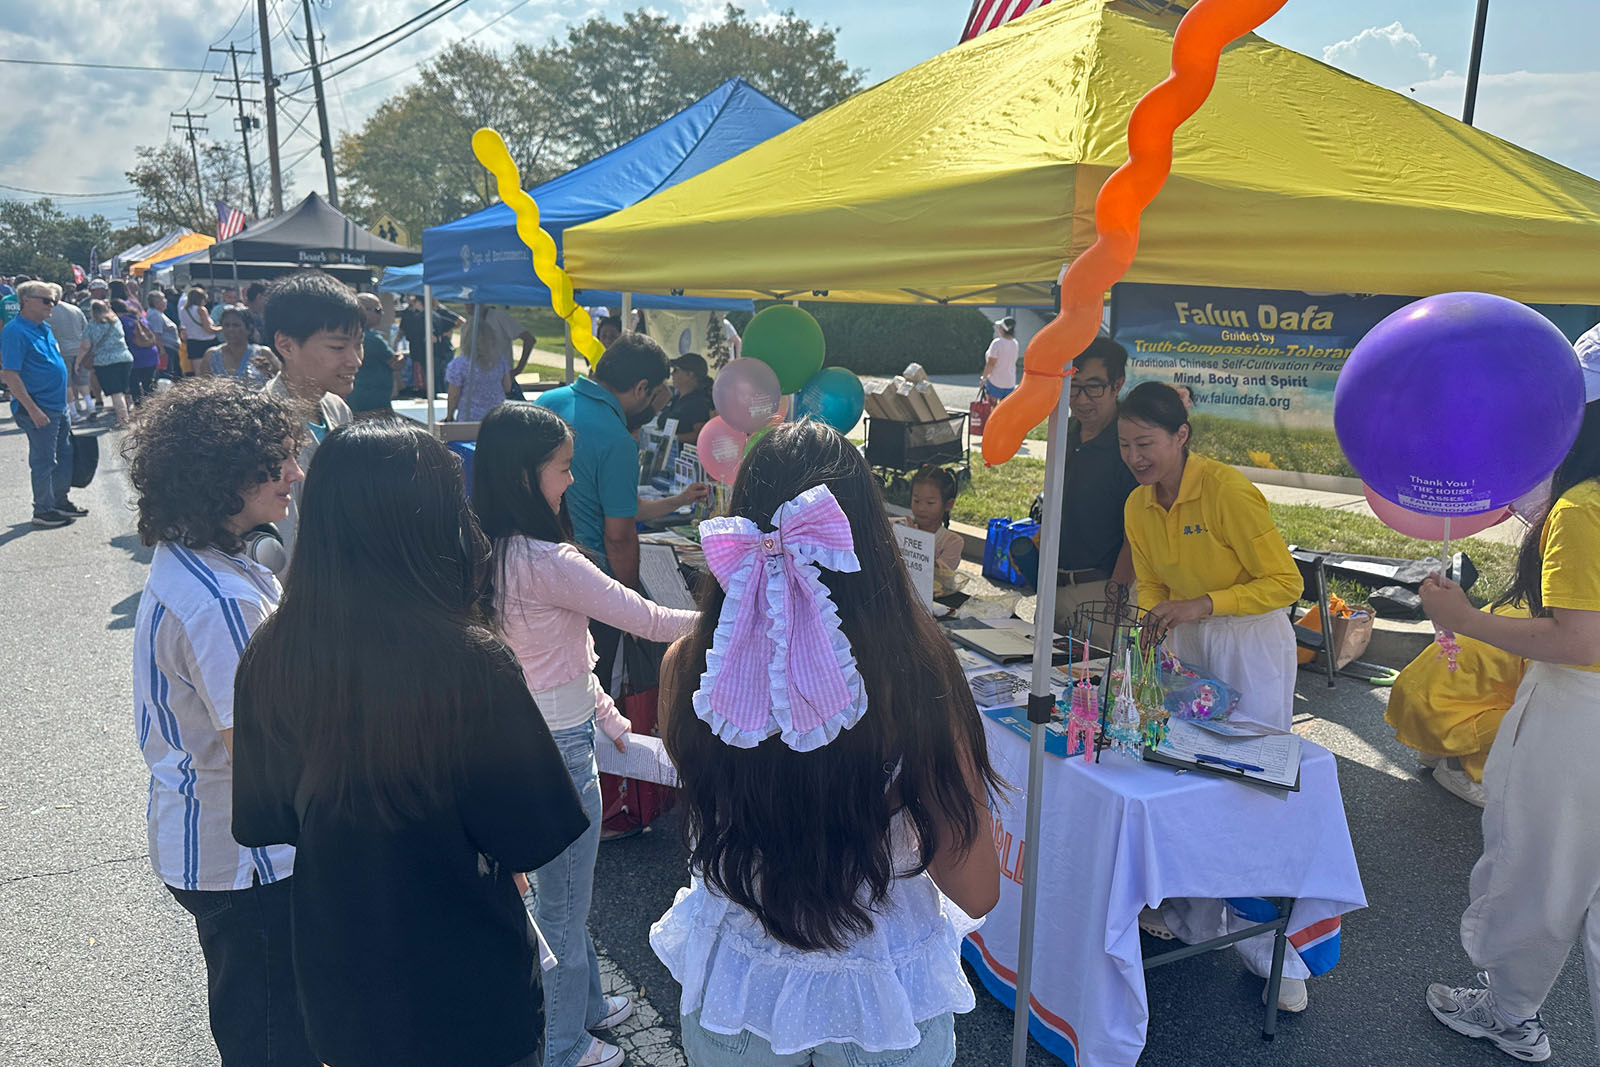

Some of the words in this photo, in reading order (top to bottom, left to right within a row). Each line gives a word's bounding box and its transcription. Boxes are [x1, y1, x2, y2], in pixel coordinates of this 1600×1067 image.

[1174, 301, 1249, 328] Falun
[1257, 304, 1334, 330] Dafa
[1221, 330, 1259, 342] Guided
[1260, 332, 1275, 344] by
[1131, 357, 1177, 368] Traditional
[1179, 358, 1218, 369] Chinese
[1221, 358, 1309, 371] Self-Cultivation
[1173, 372, 1205, 386] Mind,
[1208, 373, 1239, 388] Body
[1242, 375, 1267, 386] and
[1270, 375, 1309, 389] Spirit
[1409, 475, 1443, 487] Thank
[1411, 484, 1434, 494] THE
[1420, 493, 1465, 502] PASSES
[904, 537, 922, 550] FREE
